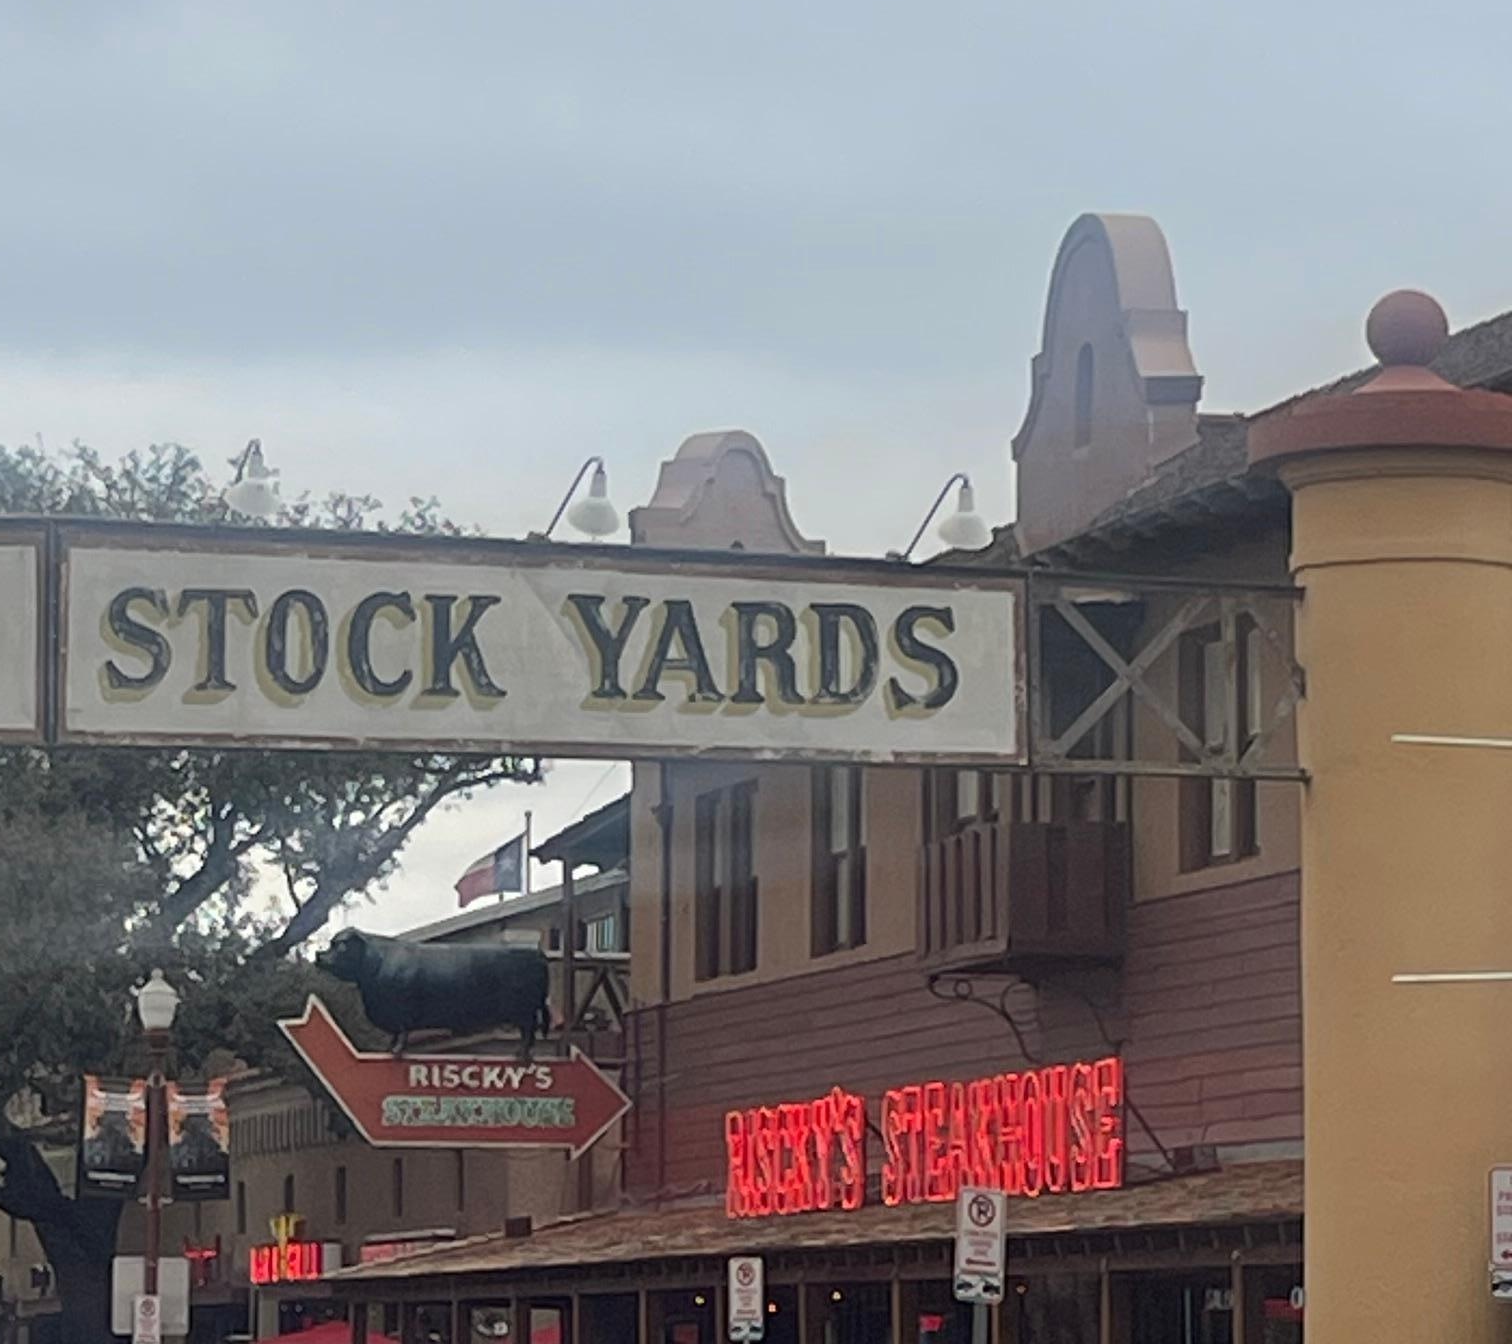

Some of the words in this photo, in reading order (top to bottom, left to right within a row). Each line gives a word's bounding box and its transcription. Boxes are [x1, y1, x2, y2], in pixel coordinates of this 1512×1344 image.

[99, 587, 507, 708] STOCK
[562, 594, 959, 718] YARDS
[408, 1063, 554, 1090] RISCKY'S
[725, 1086, 865, 1219] RISCKY'S
[881, 1056, 1125, 1206] STEAKHOUSE
